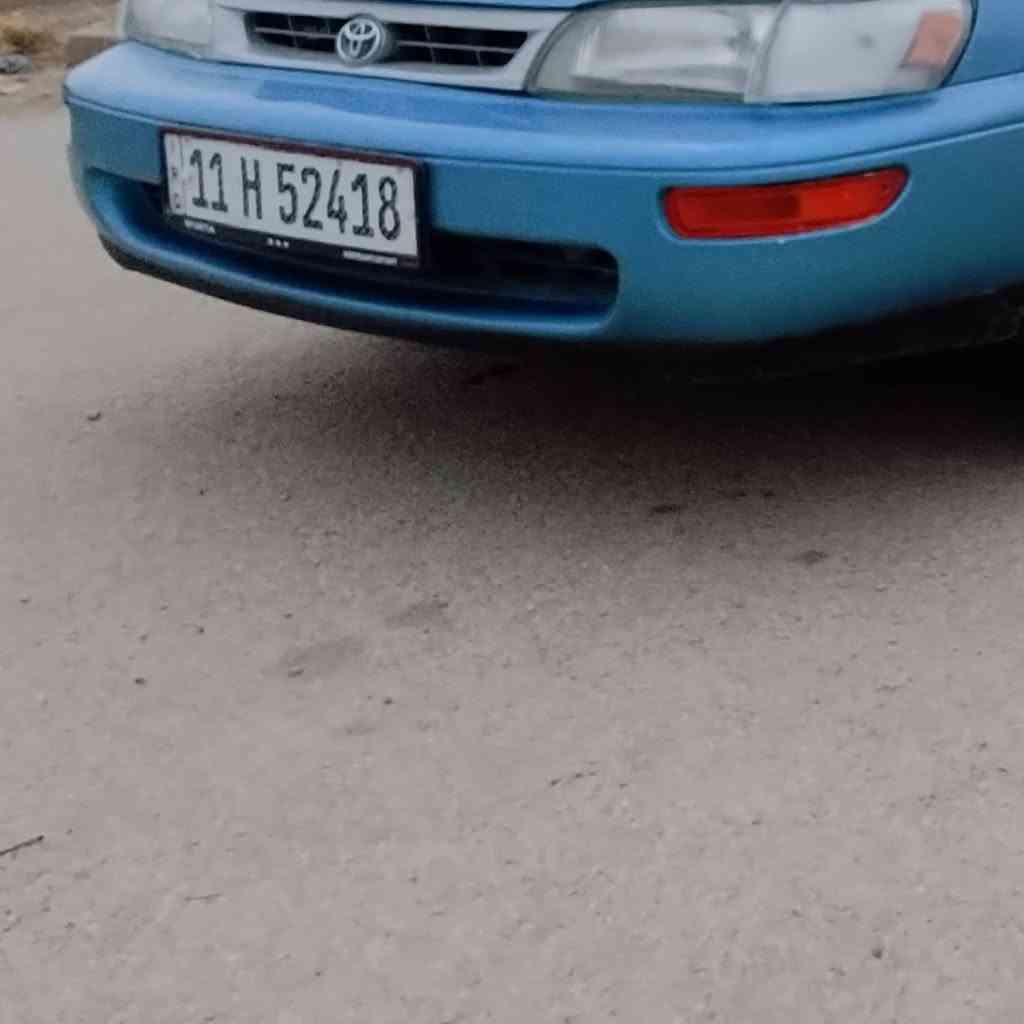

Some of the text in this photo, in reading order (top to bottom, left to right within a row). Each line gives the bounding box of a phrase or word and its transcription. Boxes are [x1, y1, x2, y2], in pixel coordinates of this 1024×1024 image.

[190, 149, 228, 212] 11
[241, 157, 262, 219] H
[276, 163, 400, 241] 52418
